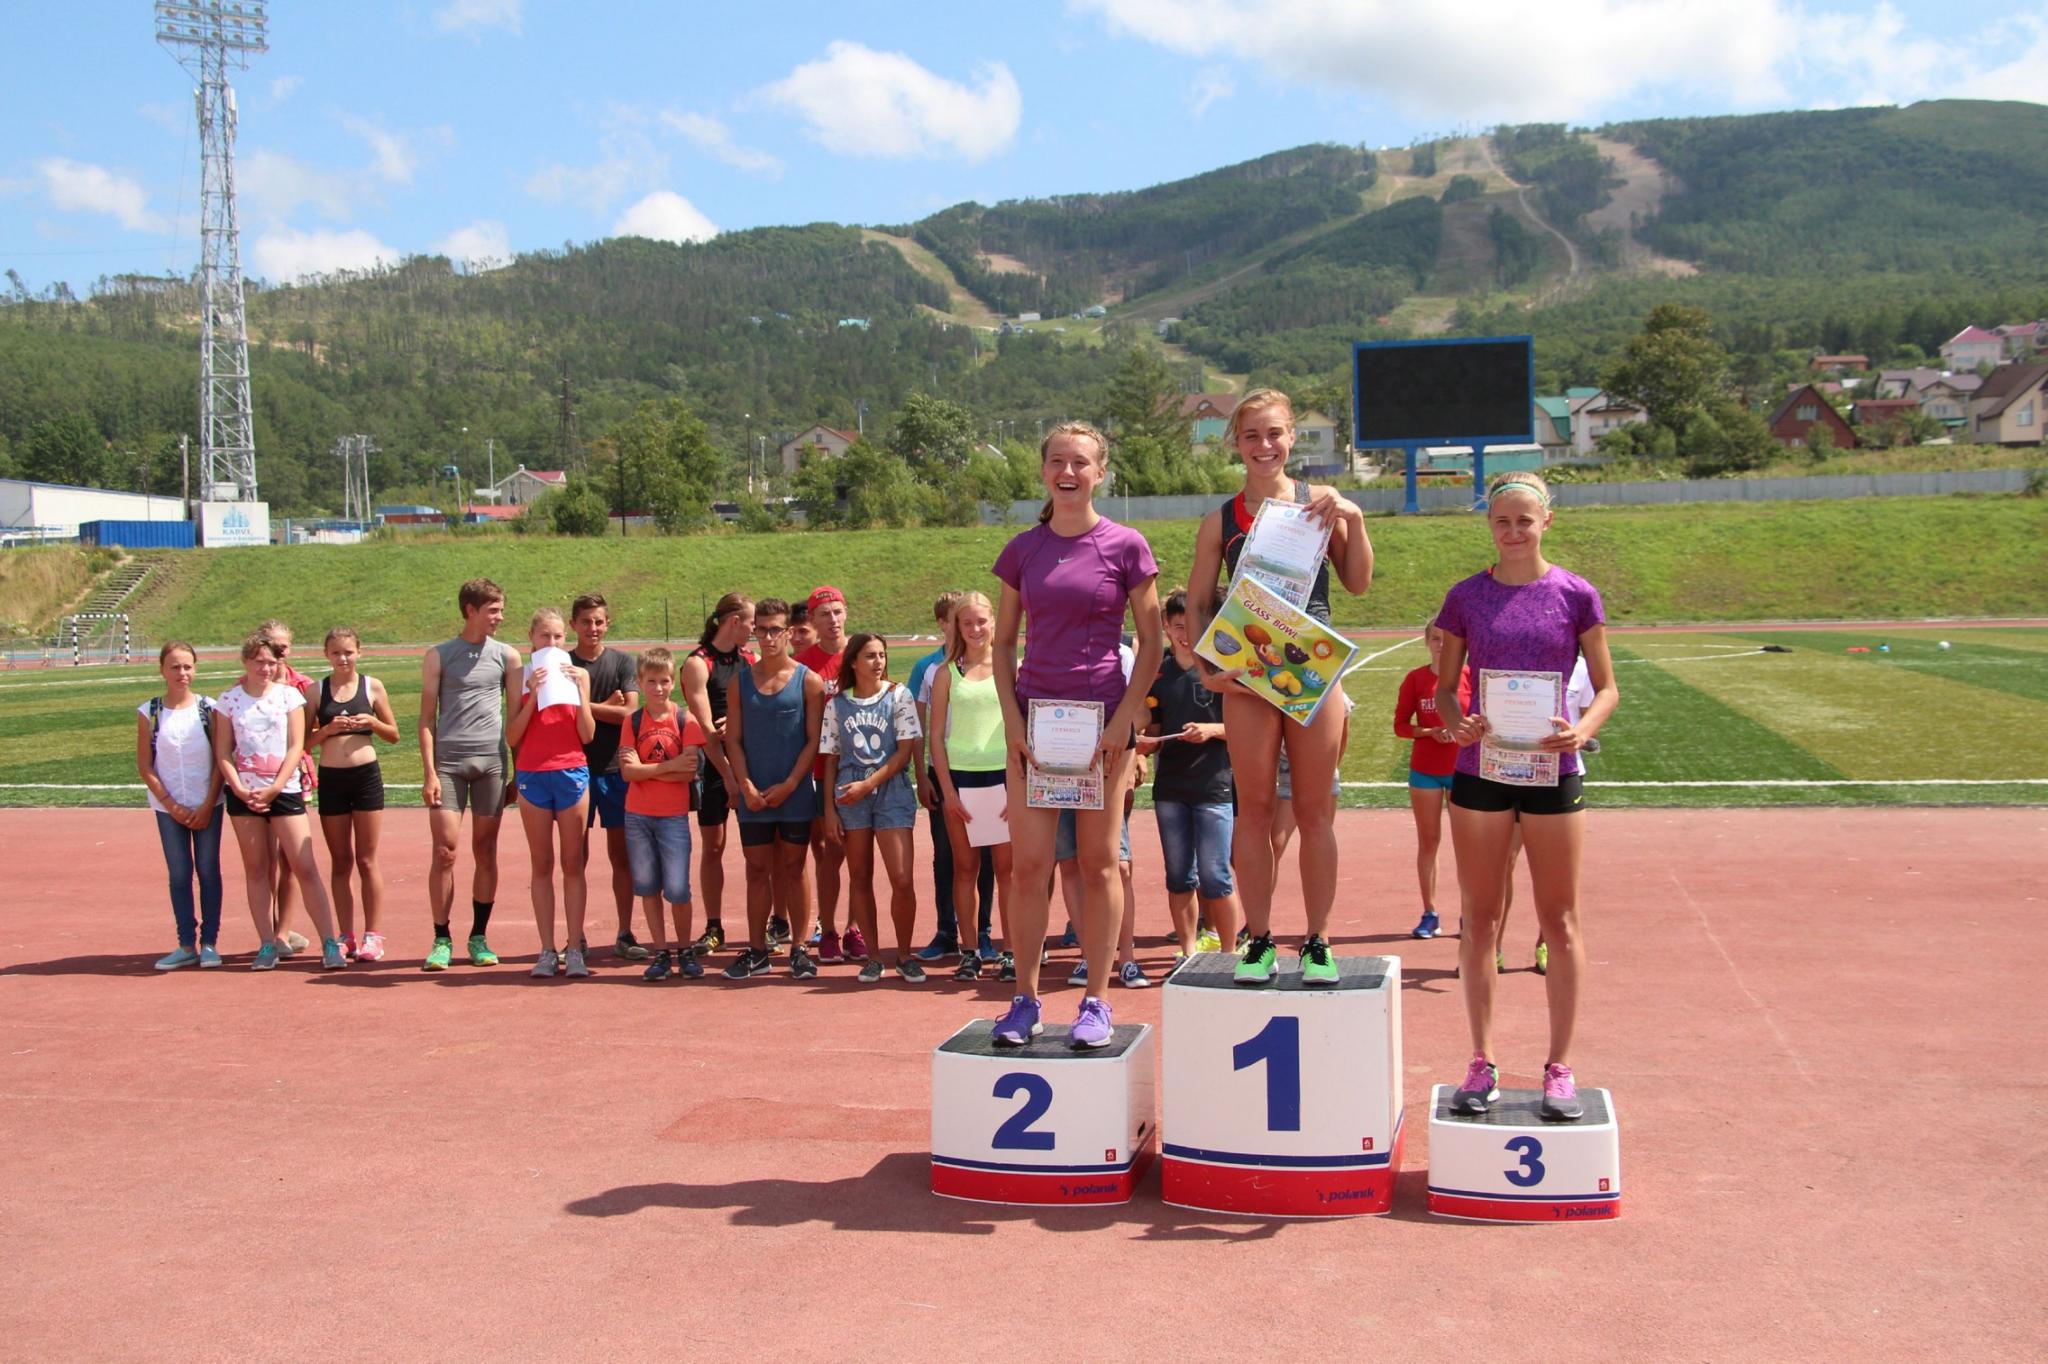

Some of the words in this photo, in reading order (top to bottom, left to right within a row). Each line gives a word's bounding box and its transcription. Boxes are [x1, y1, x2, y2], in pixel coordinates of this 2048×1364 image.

[1244, 600, 1271, 620] GLASS
[1273, 619, 1298, 639] BOWL
[1233, 1017, 1300, 1131] 1
[992, 1074, 1055, 1150] 2
[1505, 1136, 1545, 1187] 3
[1072, 1184, 1117, 1197] polanik
[1328, 1187, 1374, 1202] polanik
[1565, 1205, 1611, 1218] polanik
